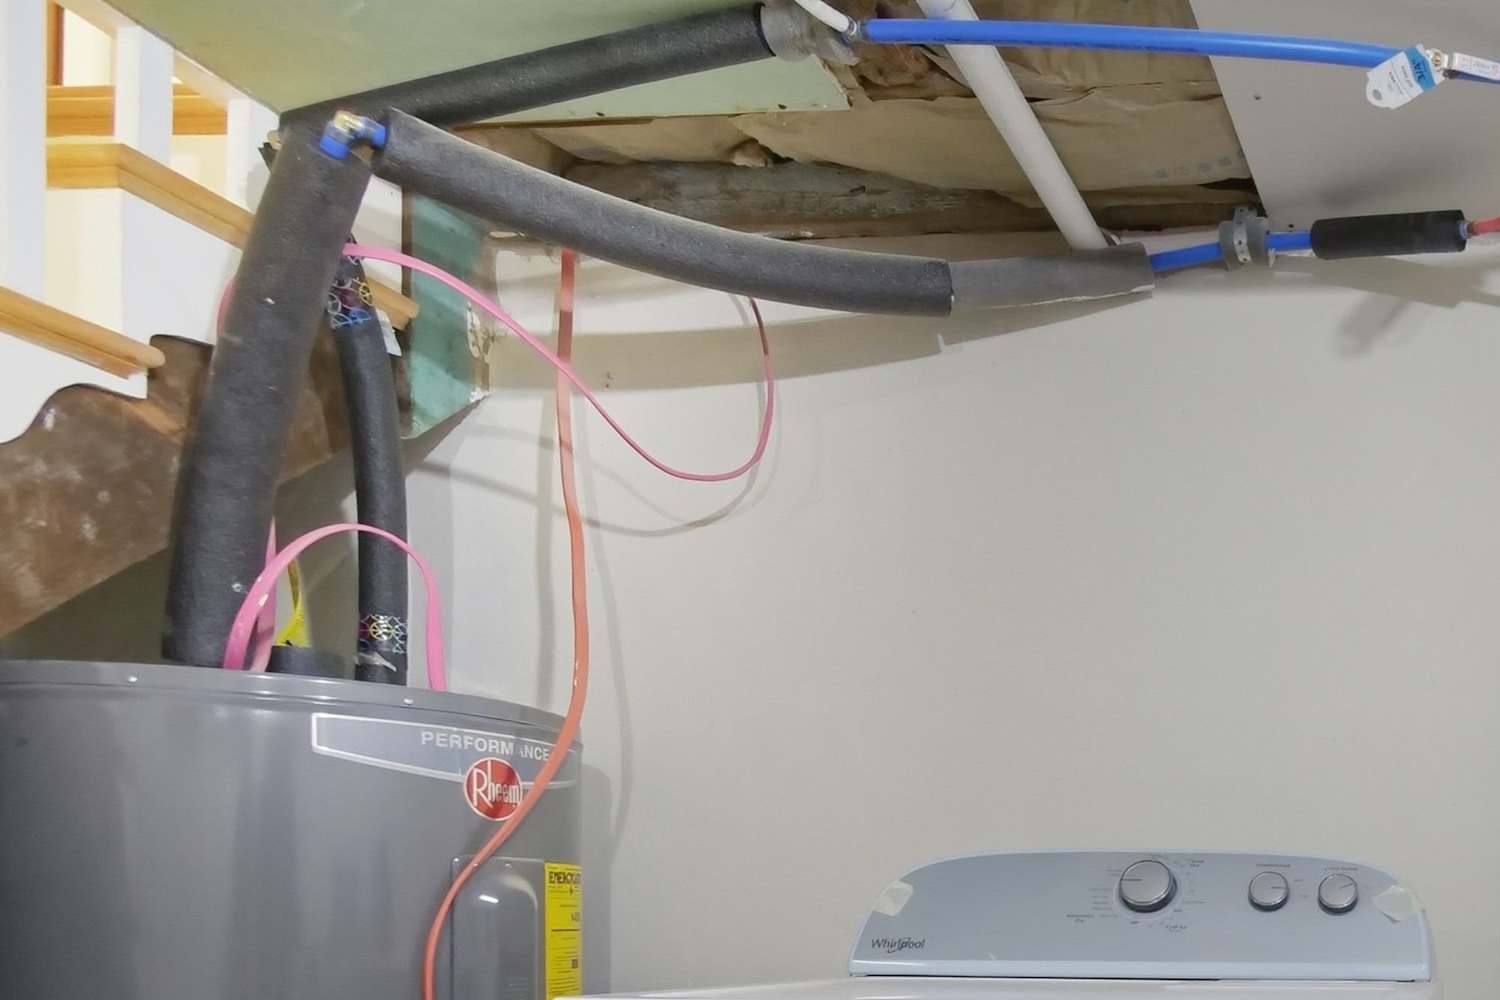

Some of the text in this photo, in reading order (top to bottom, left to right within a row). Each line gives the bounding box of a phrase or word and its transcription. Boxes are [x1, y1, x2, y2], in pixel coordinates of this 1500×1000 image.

[421, 731, 551, 761] PERFORMANCE
[472, 760, 520, 808] Rheem
[871, 937, 926, 953] Whirlpool
